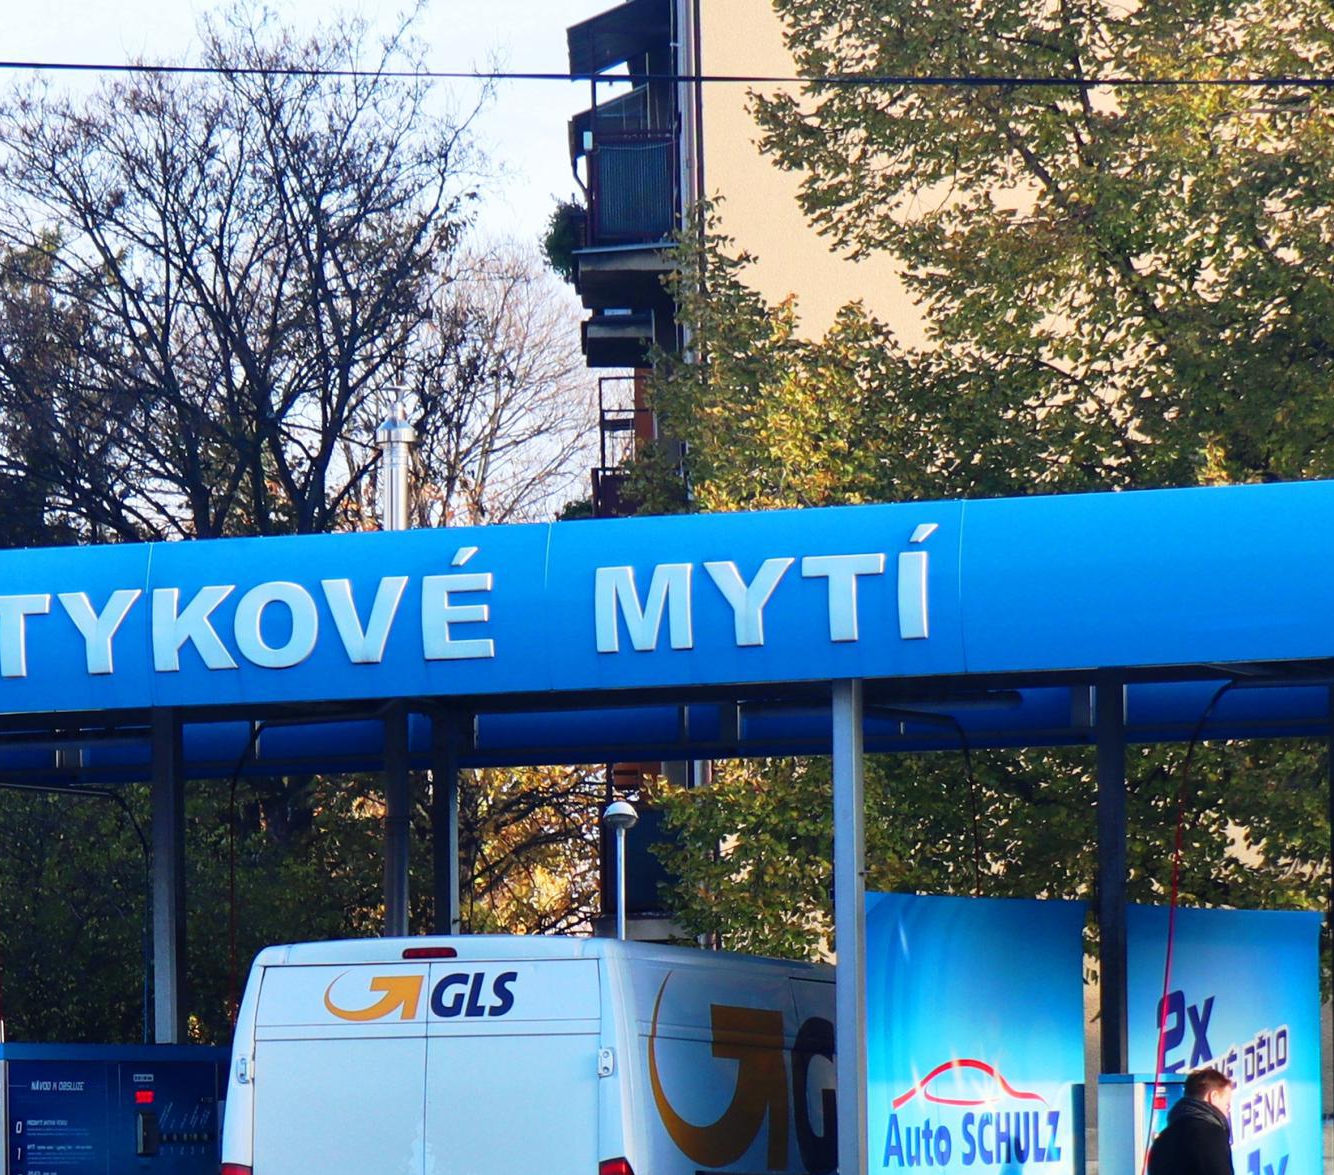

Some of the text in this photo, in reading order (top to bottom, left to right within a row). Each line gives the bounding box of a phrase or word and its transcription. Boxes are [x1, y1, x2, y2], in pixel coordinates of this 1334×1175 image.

[594, 522, 931, 653] MYTÍ
[430, 970, 517, 1018] GLS
[1244, 1028, 1287, 1084] DĚLO
[882, 1110, 1062, 1168] Auto SCHULZ
